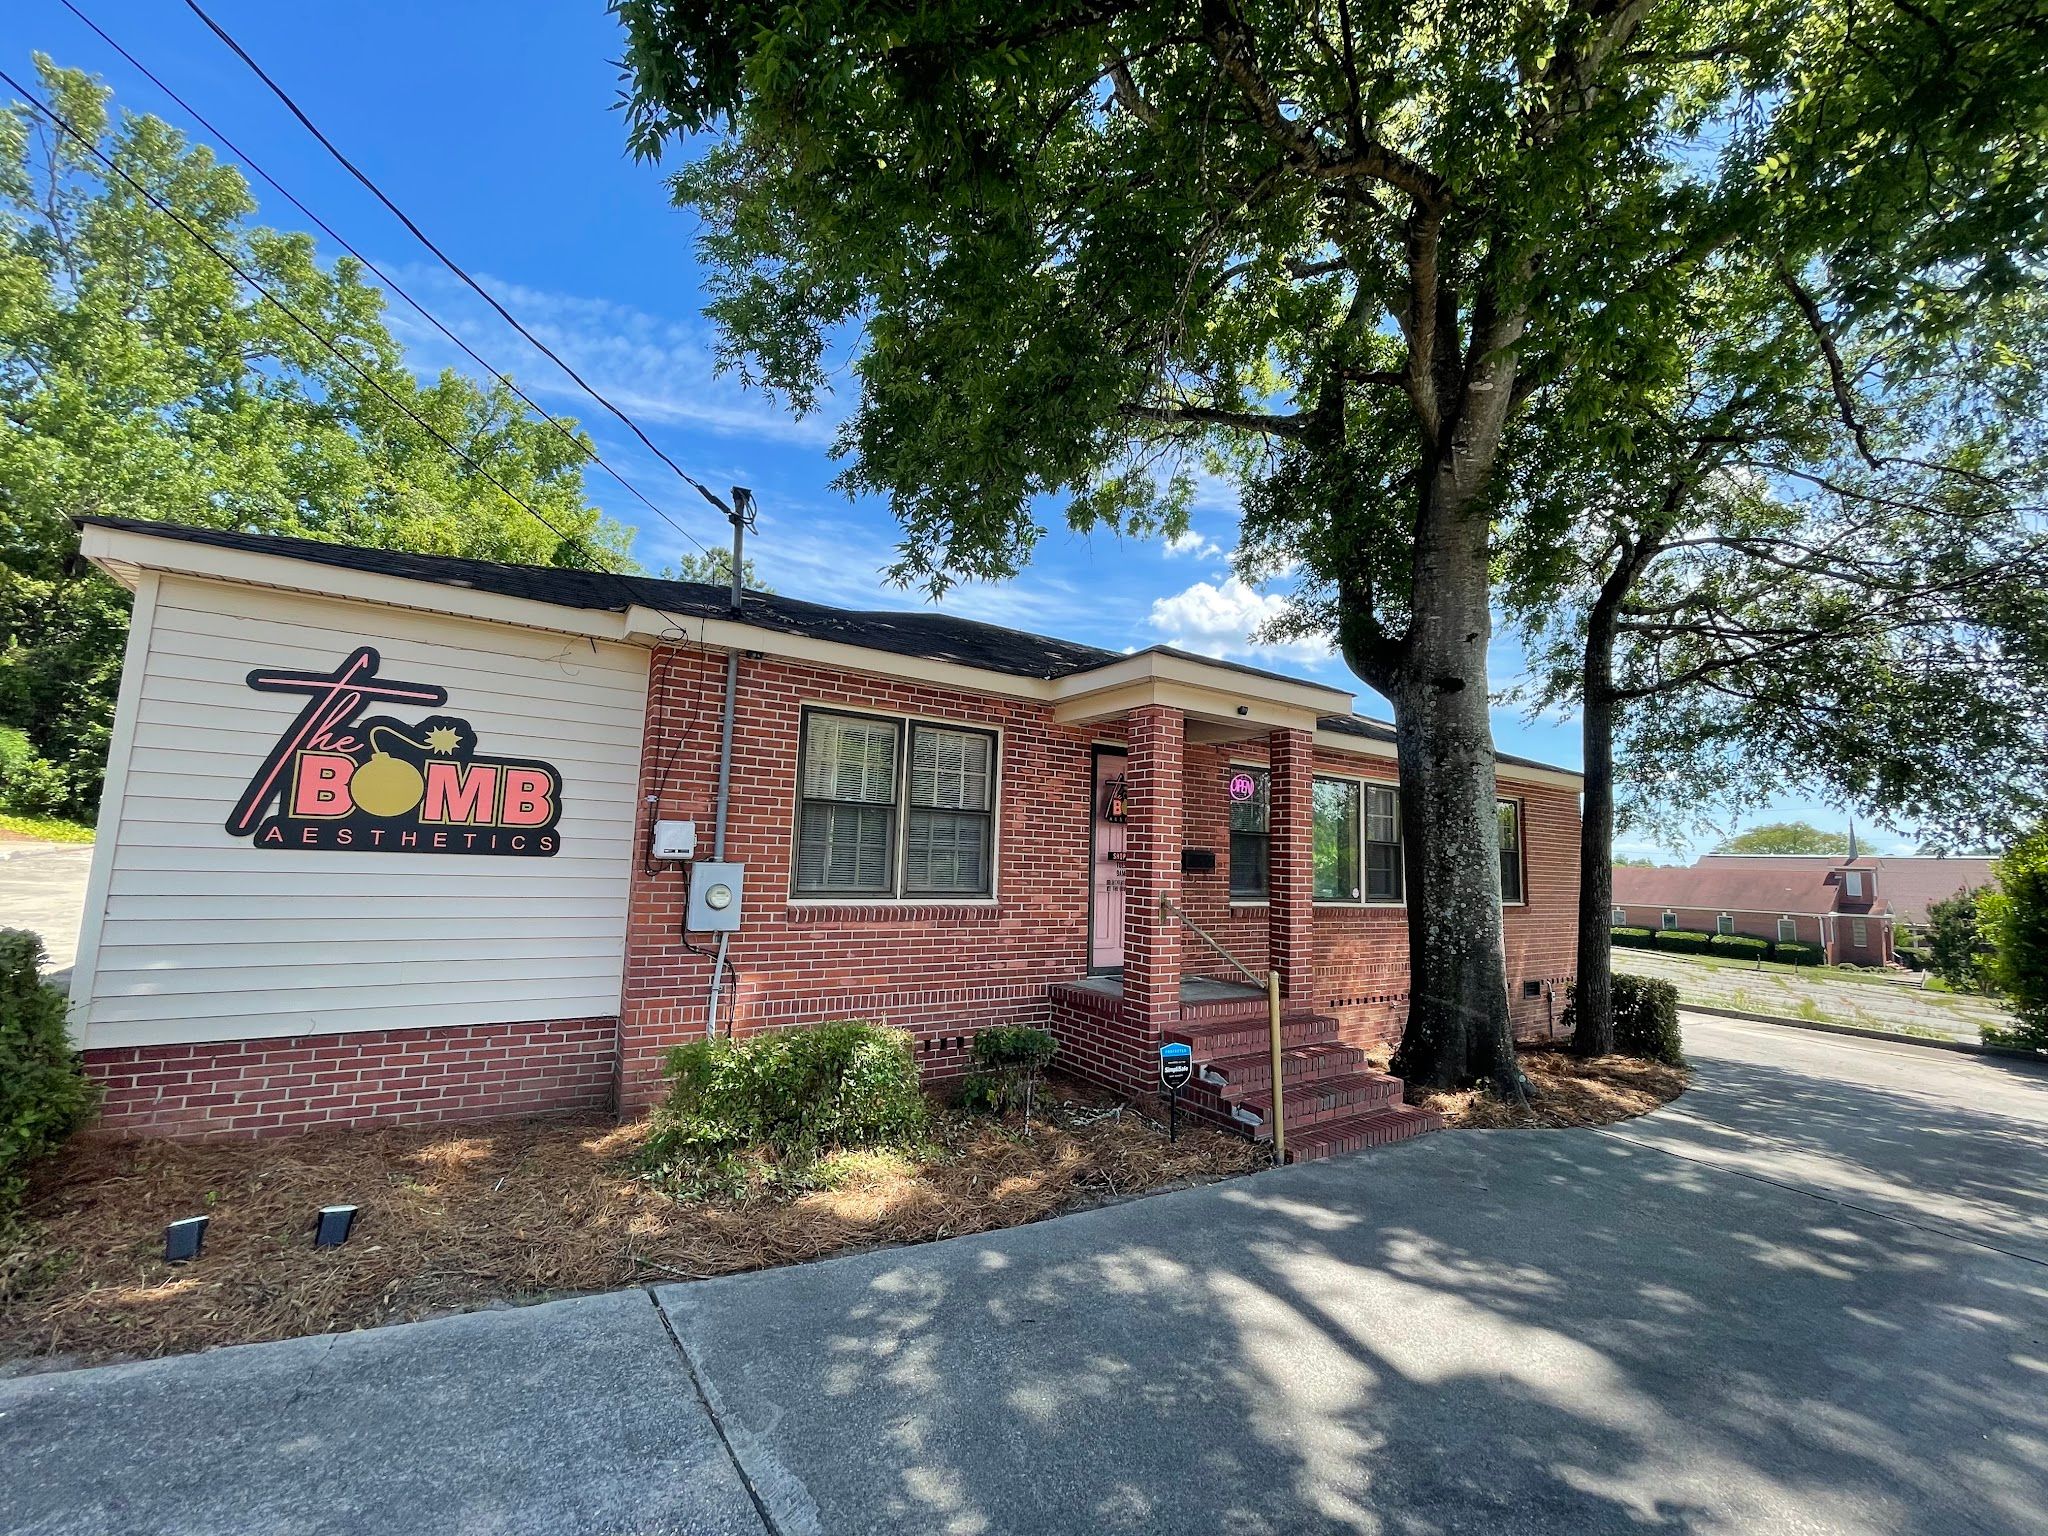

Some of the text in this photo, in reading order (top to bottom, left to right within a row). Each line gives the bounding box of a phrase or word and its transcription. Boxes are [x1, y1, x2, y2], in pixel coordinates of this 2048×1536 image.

[240, 653, 438, 829] The
[288, 749, 555, 829] BOMB
[1231, 778, 1253, 795] OPEN
[264, 826, 553, 851] AESTHETICS
[1164, 1065, 1188, 1073] SimpliSafe
